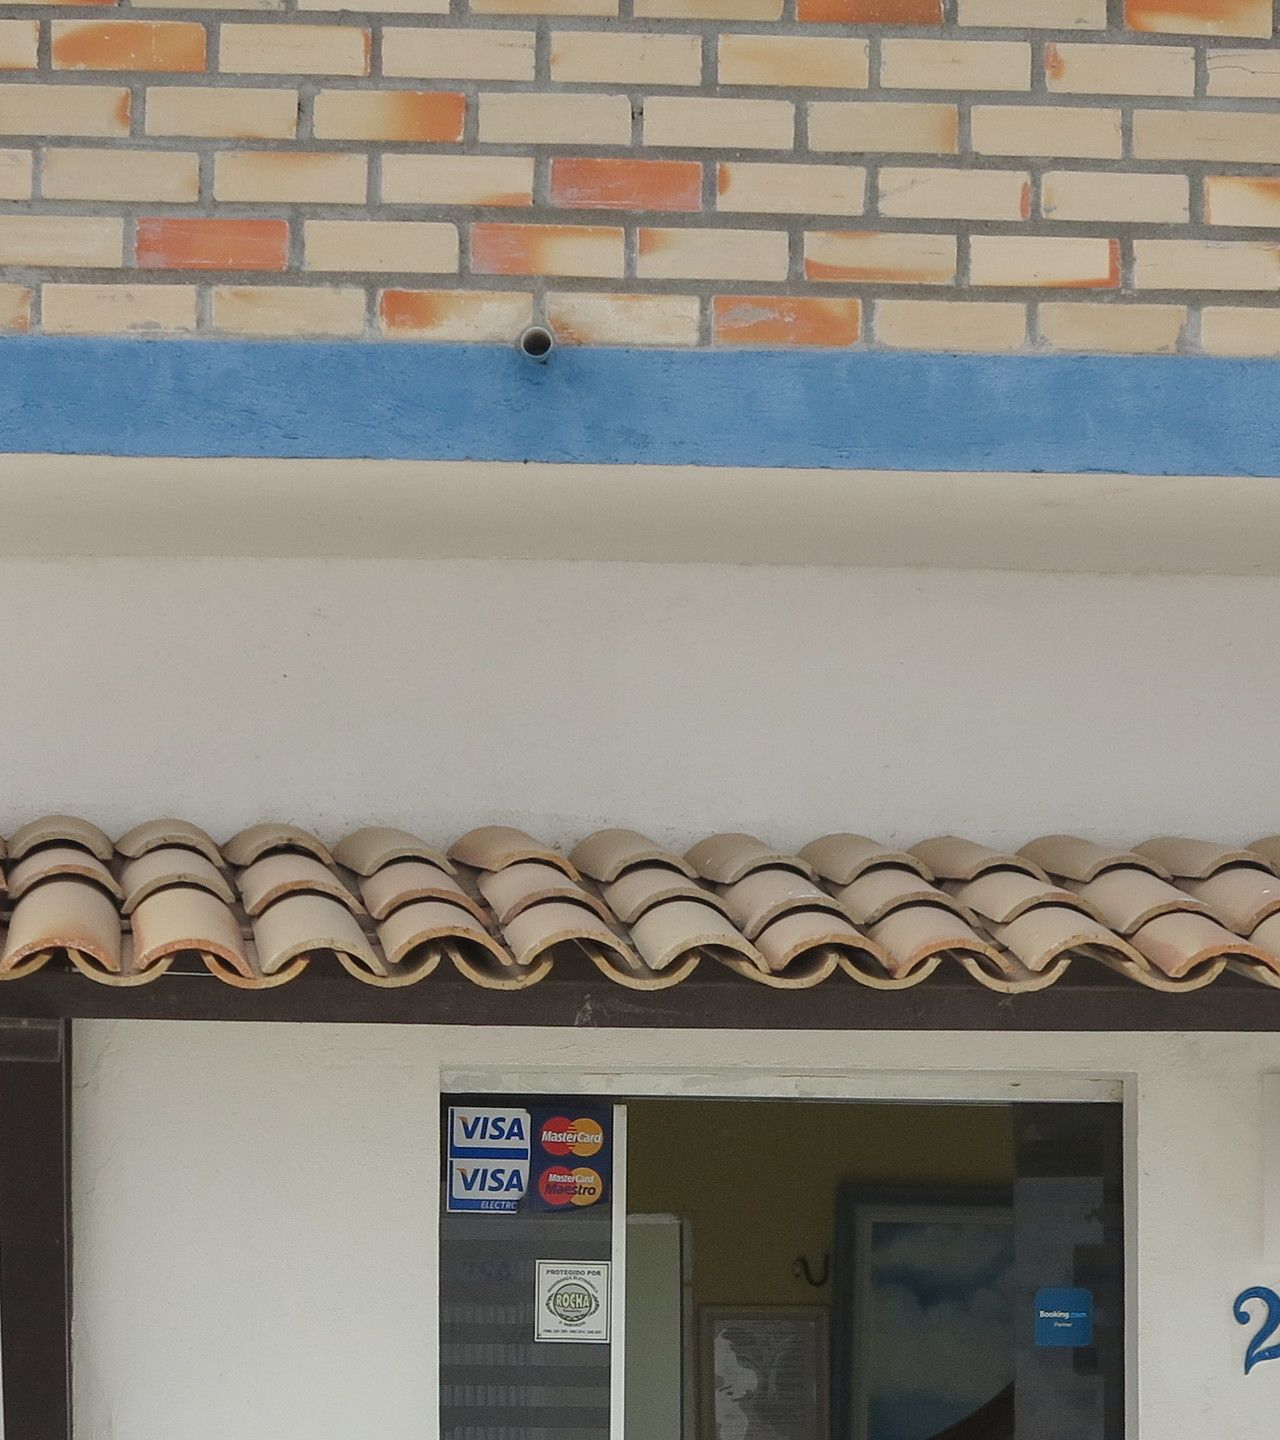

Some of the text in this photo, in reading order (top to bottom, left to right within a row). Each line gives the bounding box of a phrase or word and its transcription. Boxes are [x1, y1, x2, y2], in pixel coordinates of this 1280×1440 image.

[459, 1116, 524, 1141] VISA
[541, 1130, 602, 1143] MasterCard
[457, 1167, 523, 1192] VISA
[548, 1173, 595, 1183] MasterCard
[546, 1184, 596, 1195] Maestro
[555, 1293, 592, 1309] ROCHA
[1039, 1310, 1087, 1319] Booking.com
